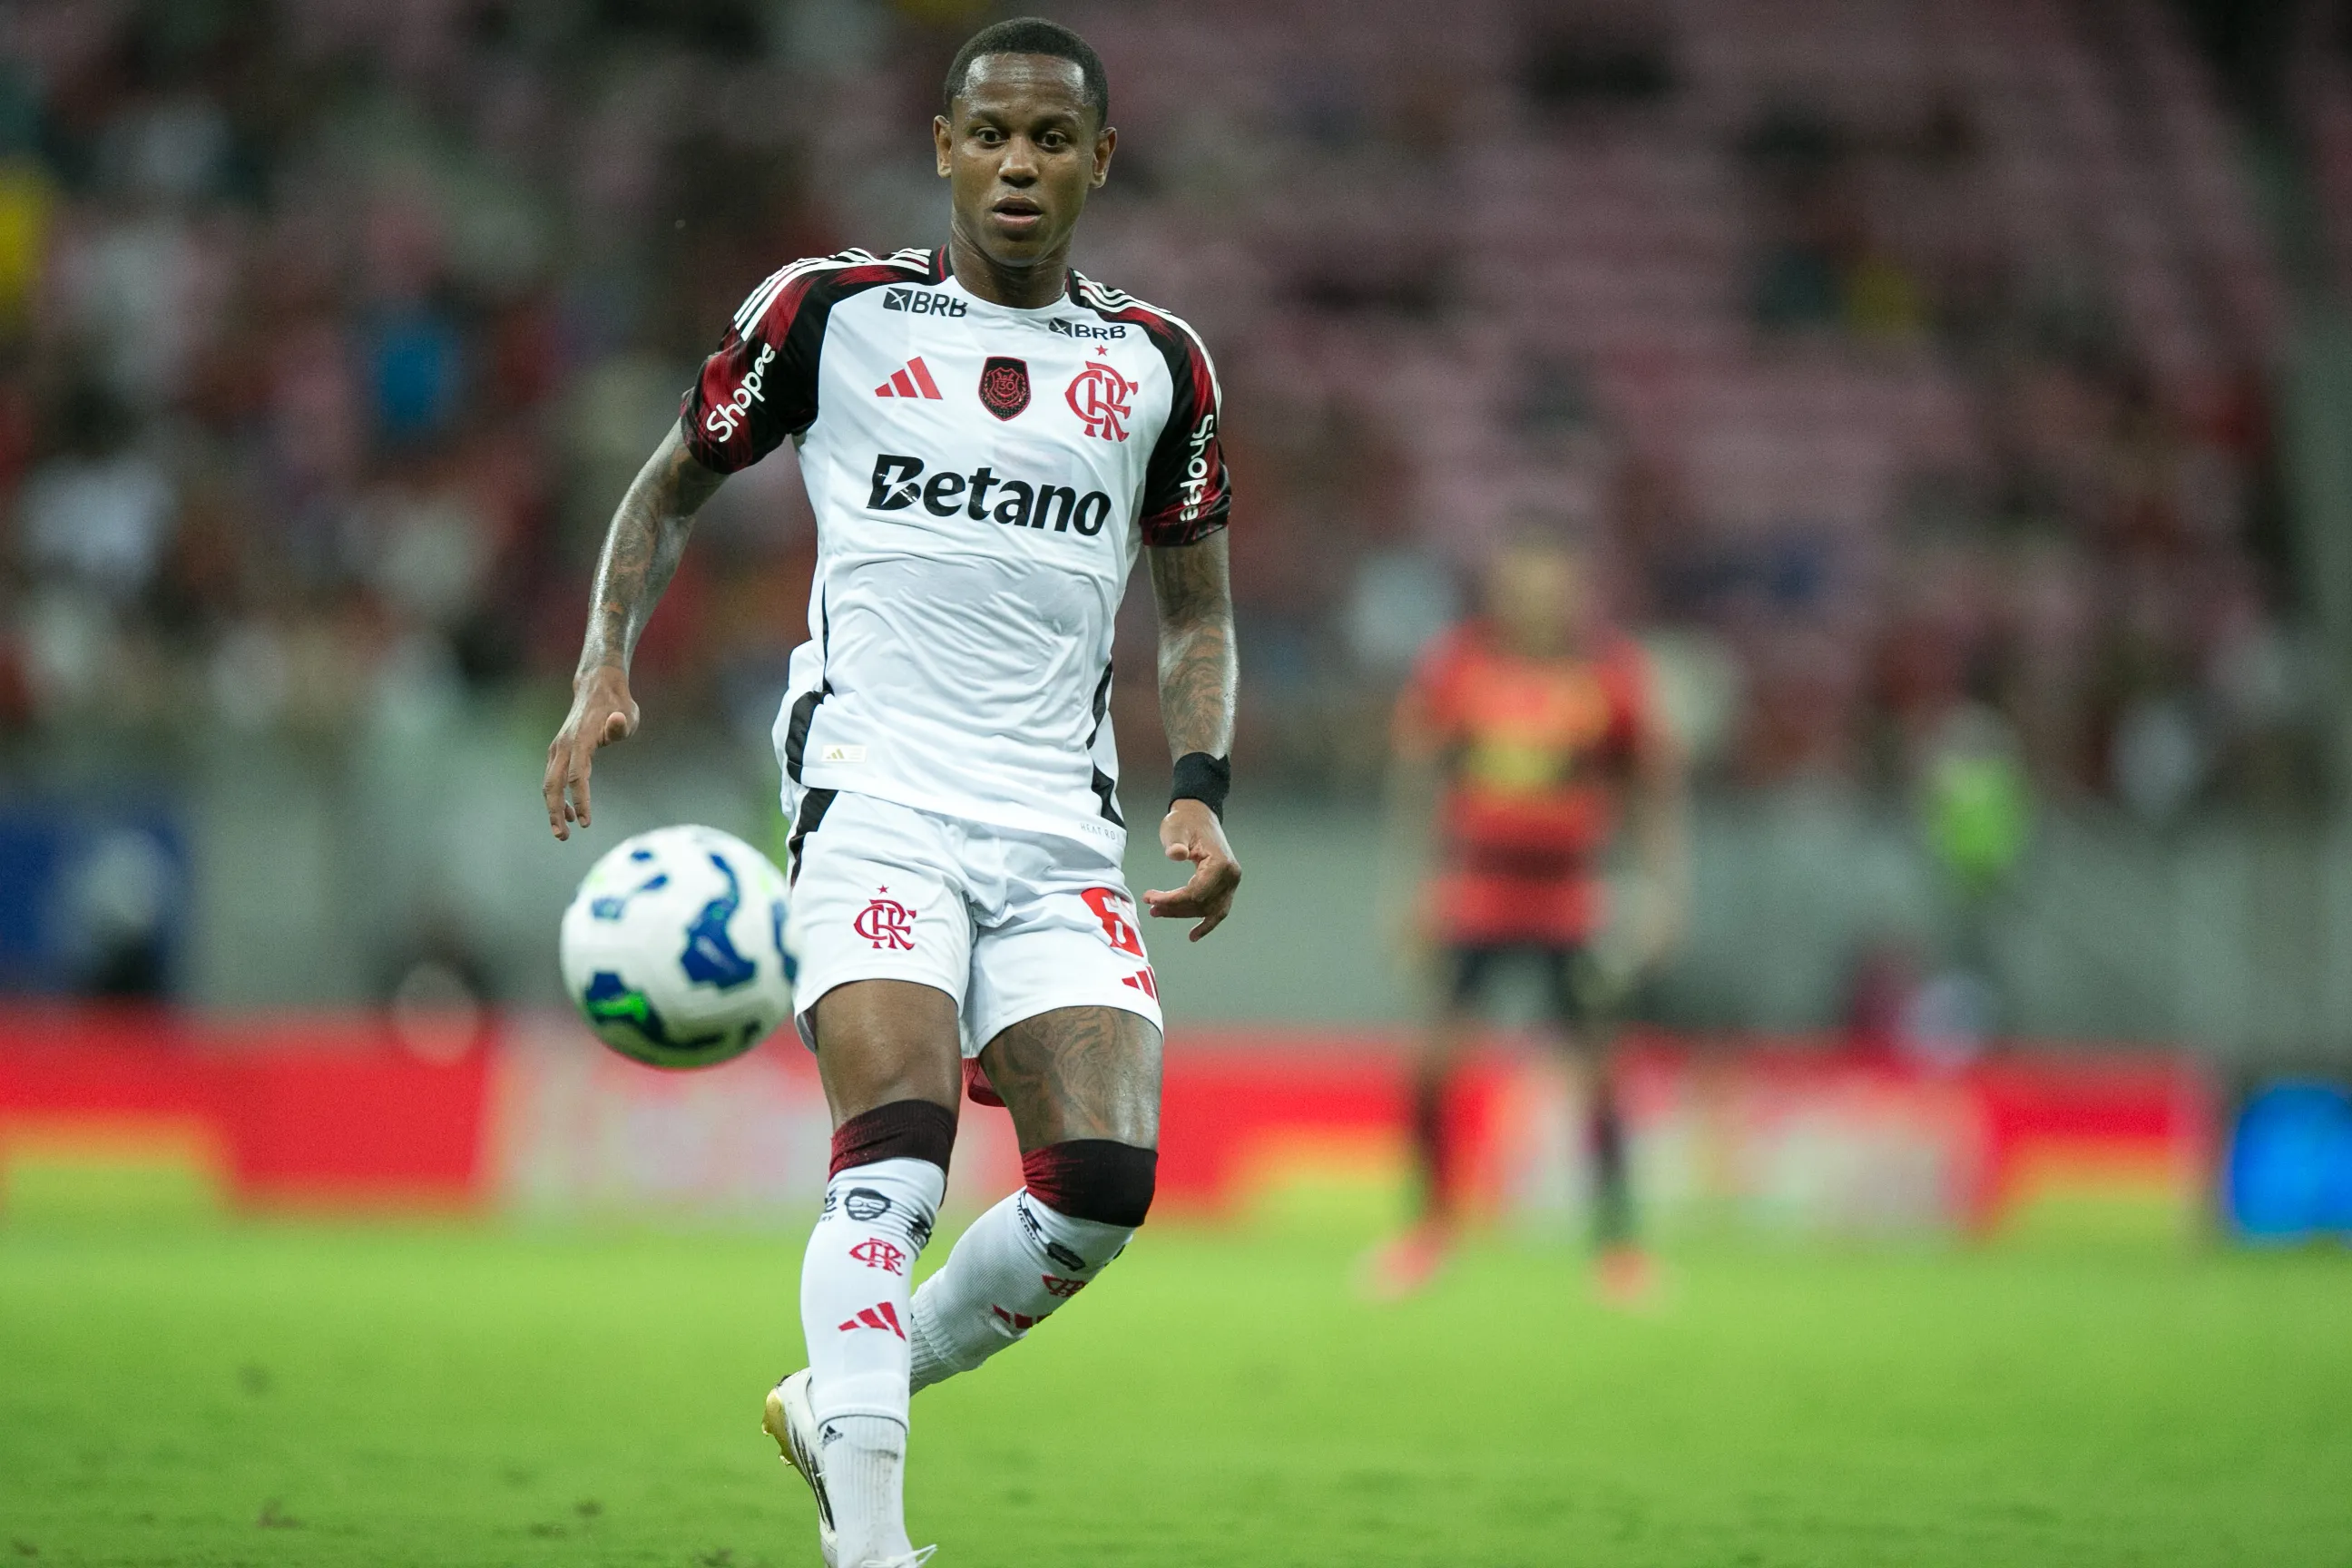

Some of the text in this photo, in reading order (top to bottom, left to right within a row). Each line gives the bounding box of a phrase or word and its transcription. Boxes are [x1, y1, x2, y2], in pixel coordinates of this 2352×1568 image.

[911, 290, 968, 317] BRB
[1074, 324, 1127, 340] BRB
[706, 343, 776, 442] Shopee
[867, 454, 1112, 536] Betano
[1180, 414, 1214, 521] Shopee
